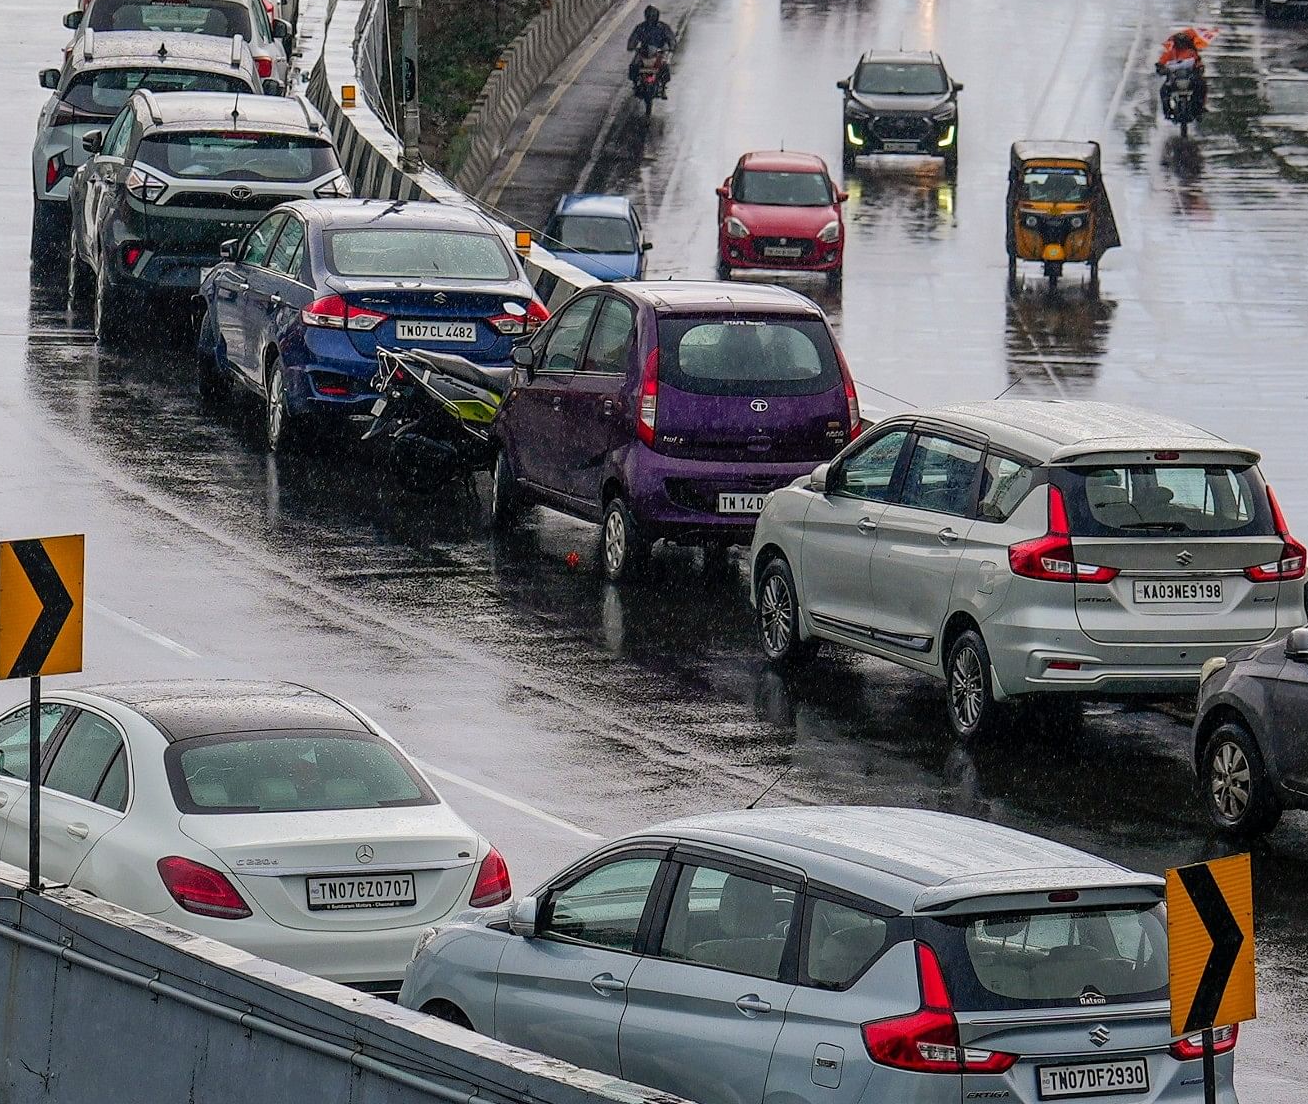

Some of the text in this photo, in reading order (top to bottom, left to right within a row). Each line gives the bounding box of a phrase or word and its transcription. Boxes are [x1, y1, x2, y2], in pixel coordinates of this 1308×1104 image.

[445, 325, 474, 339] 4482
[740, 496, 753, 509] 14
[1143, 584, 1221, 599] KA03NE9198
[318, 880, 411, 899] TN07CZ0707
[1050, 1066, 1143, 1091] TN07DF2930
[966, 1089, 1010, 1100] ERTIGA
